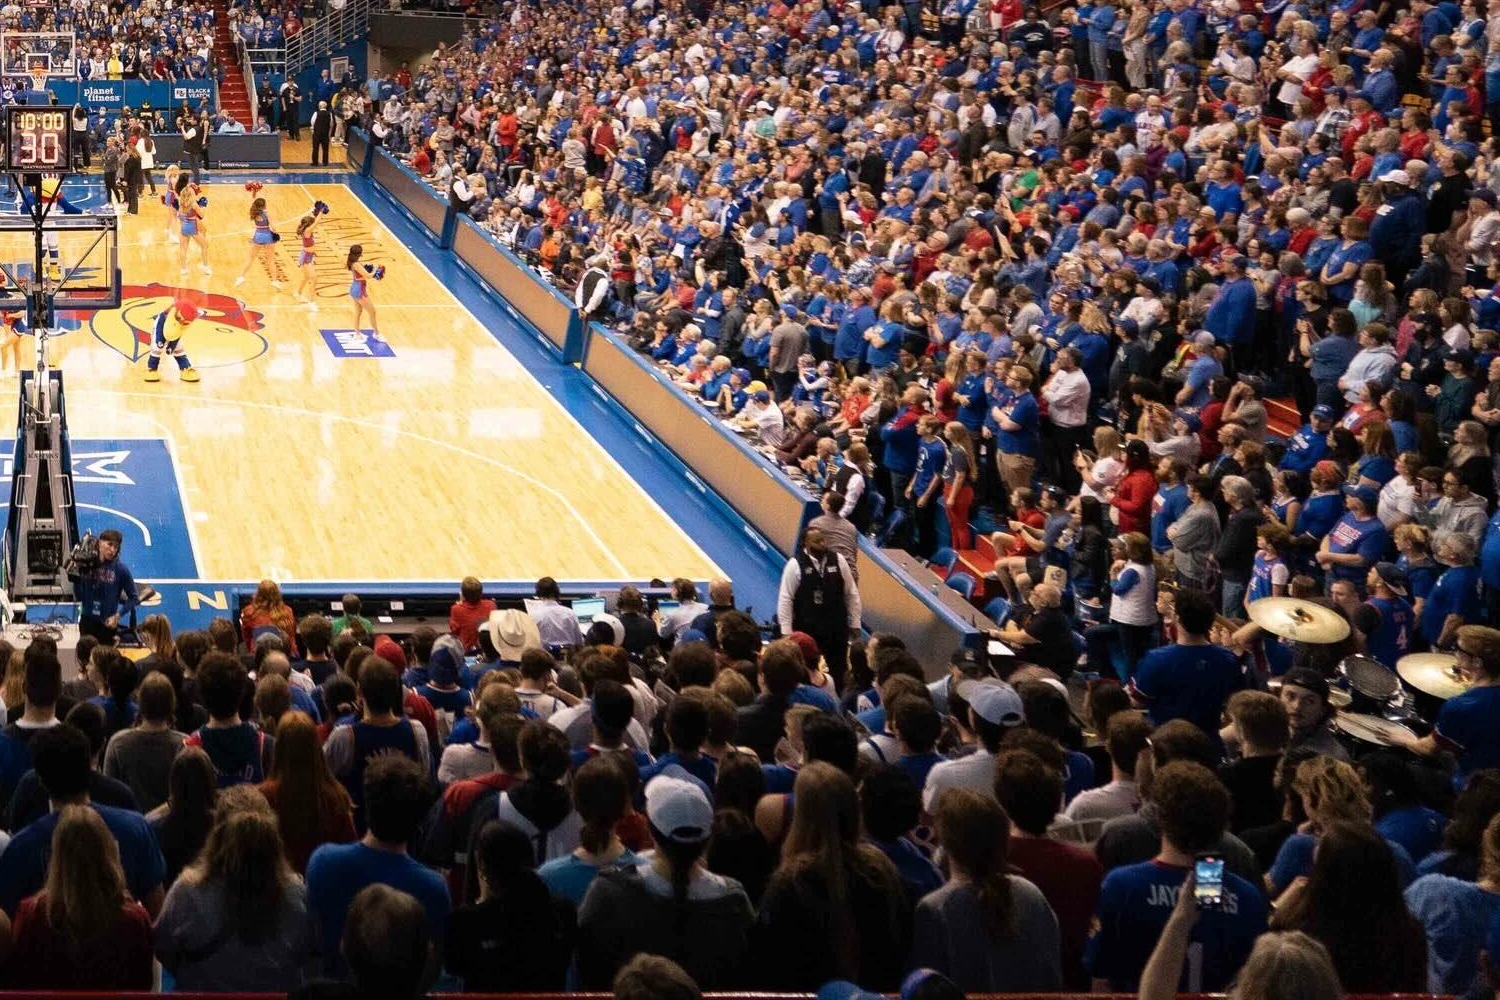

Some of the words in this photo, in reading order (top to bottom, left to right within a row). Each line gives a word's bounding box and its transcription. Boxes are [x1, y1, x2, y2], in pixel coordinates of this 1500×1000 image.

[83, 87, 114, 97] planet
[87, 94, 120, 102] fitness
[20, 113, 64, 131] 10:00
[21, 132, 59, 164] 30
